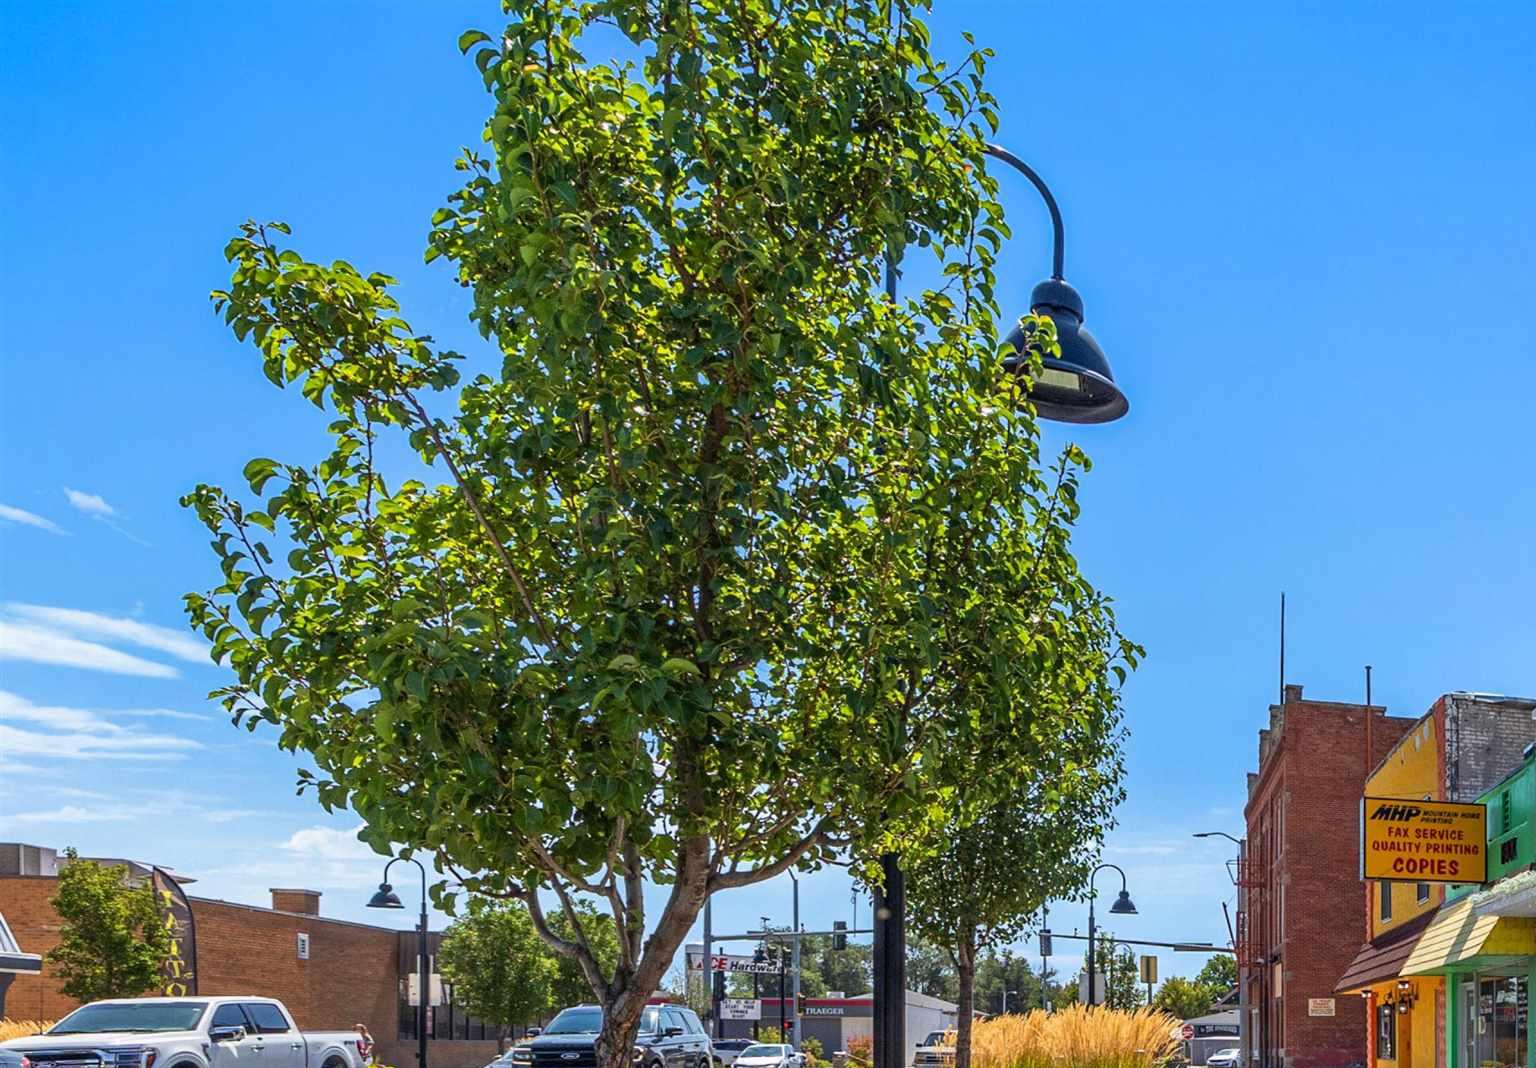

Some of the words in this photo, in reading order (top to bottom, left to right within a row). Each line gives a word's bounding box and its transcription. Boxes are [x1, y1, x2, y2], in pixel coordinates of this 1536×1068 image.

[1370, 804, 1421, 821] MHP
[1387, 826, 1409, 838] FAX
[1415, 828, 1464, 841] SERVICE
[1372, 840, 1421, 853] QUALITY
[1426, 843, 1479, 856] PRINTING
[1393, 857, 1459, 876] COPIES
[805, 1007, 845, 1015] TRAEGER
